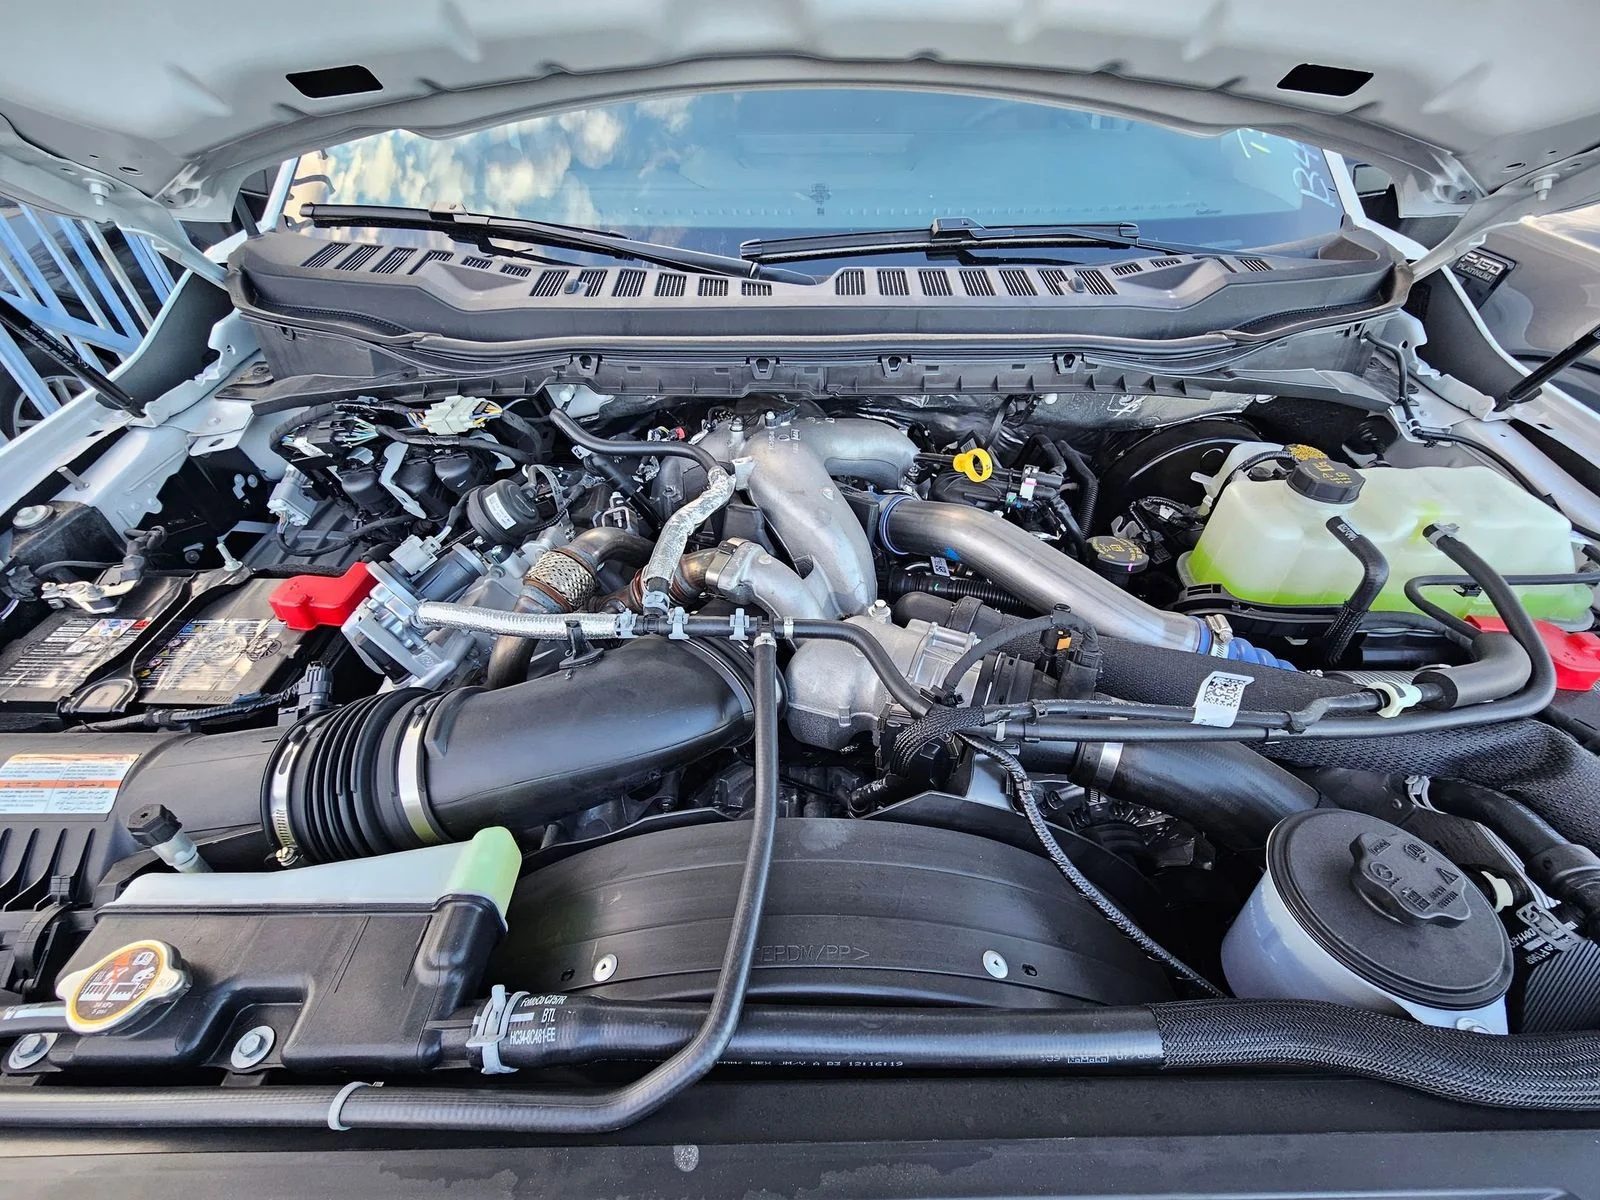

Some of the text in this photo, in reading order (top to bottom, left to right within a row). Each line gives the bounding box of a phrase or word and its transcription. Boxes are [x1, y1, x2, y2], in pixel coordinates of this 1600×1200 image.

[1456, 263, 1493, 282] PLATINUM
[758, 944, 870, 962] EPDM/PP>
[520, 996, 544, 1007] FoMoCo
[541, 1008, 556, 1022] BTL
